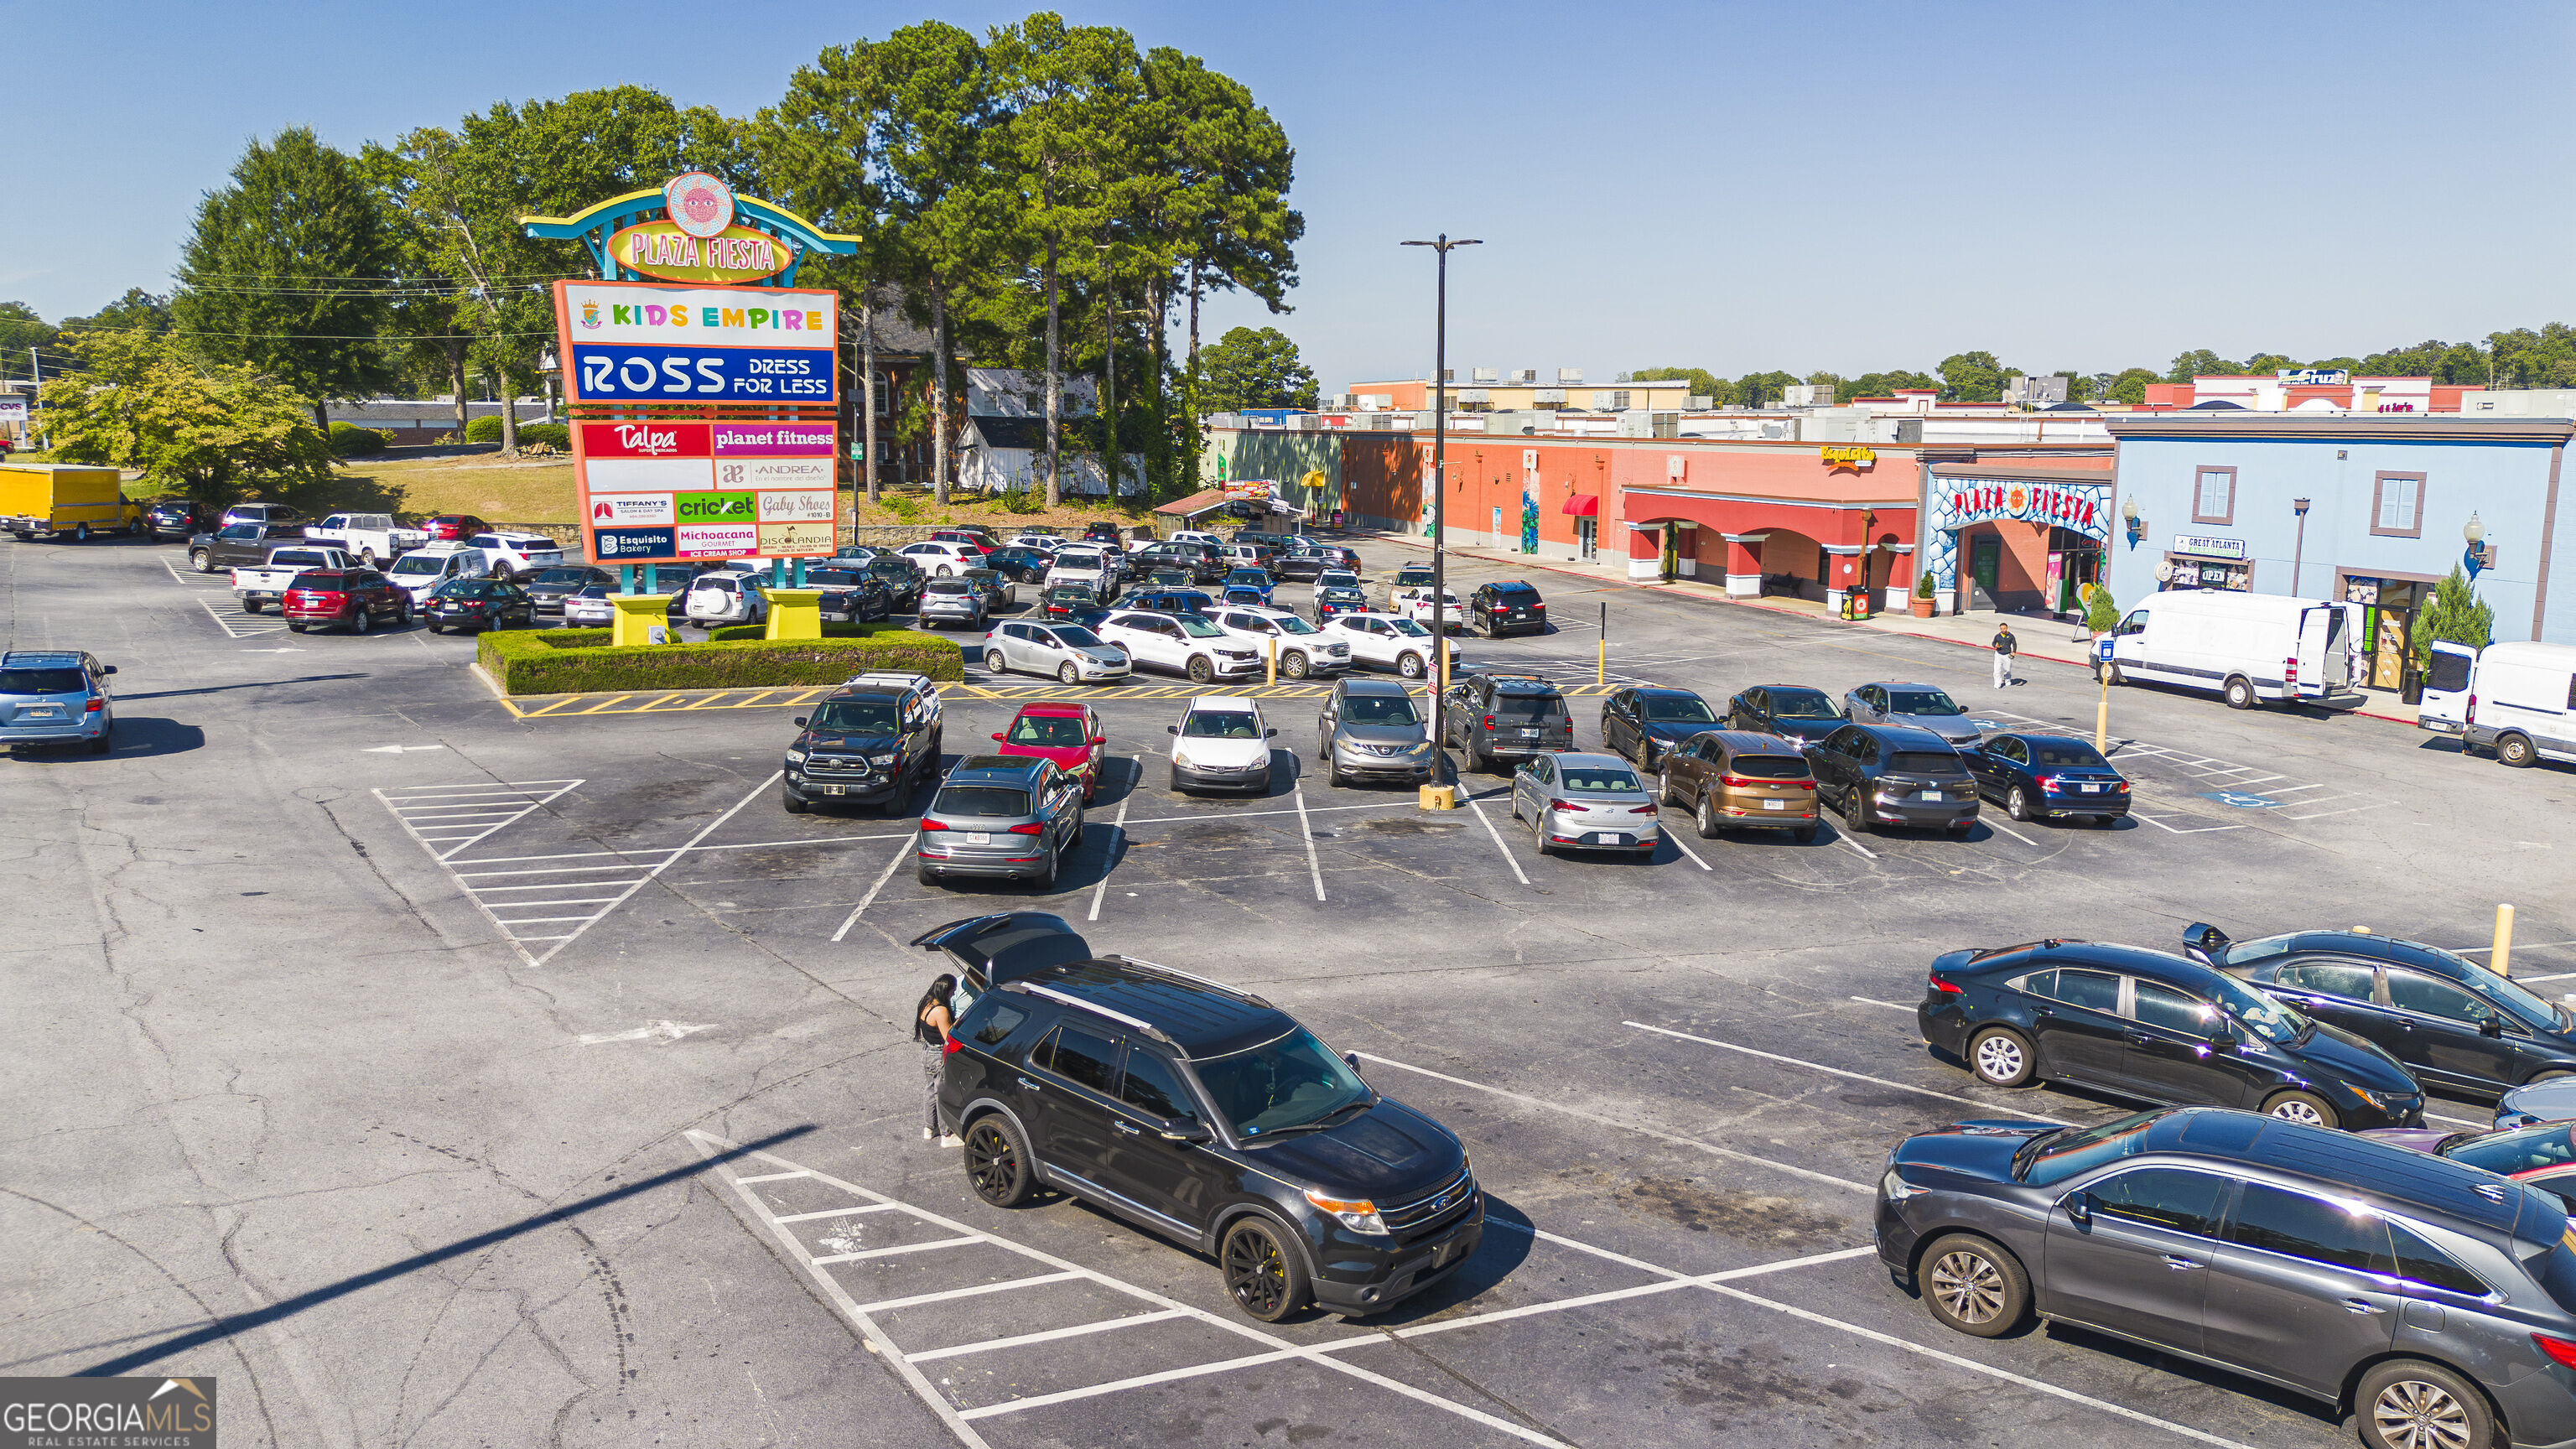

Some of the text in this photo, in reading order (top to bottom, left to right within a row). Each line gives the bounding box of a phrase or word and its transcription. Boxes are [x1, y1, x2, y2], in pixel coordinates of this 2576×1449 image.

[631, 233, 776, 271] PLAZA FIESTA
[613, 304, 823, 330] KIDS EMPIRE
[584, 356, 725, 393] ROSS
[749, 358, 811, 375] DRESS
[734, 378, 828, 394] FOR LESS
[614, 424, 677, 455] Talpa
[716, 430, 834, 449] planet fitness
[679, 496, 754, 516] cricket
[763, 495, 830, 516] Gaby Shoes
[1955, 486, 2094, 527] PLAZA FIESTA
[620, 535, 667, 546] Esquisito
[681, 531, 755, 540] Michoacana
[2189, 538, 2240, 550] GREAT ATLANTA
[621, 545, 652, 553] Bakery
[2202, 570, 2225, 582] OPEN
